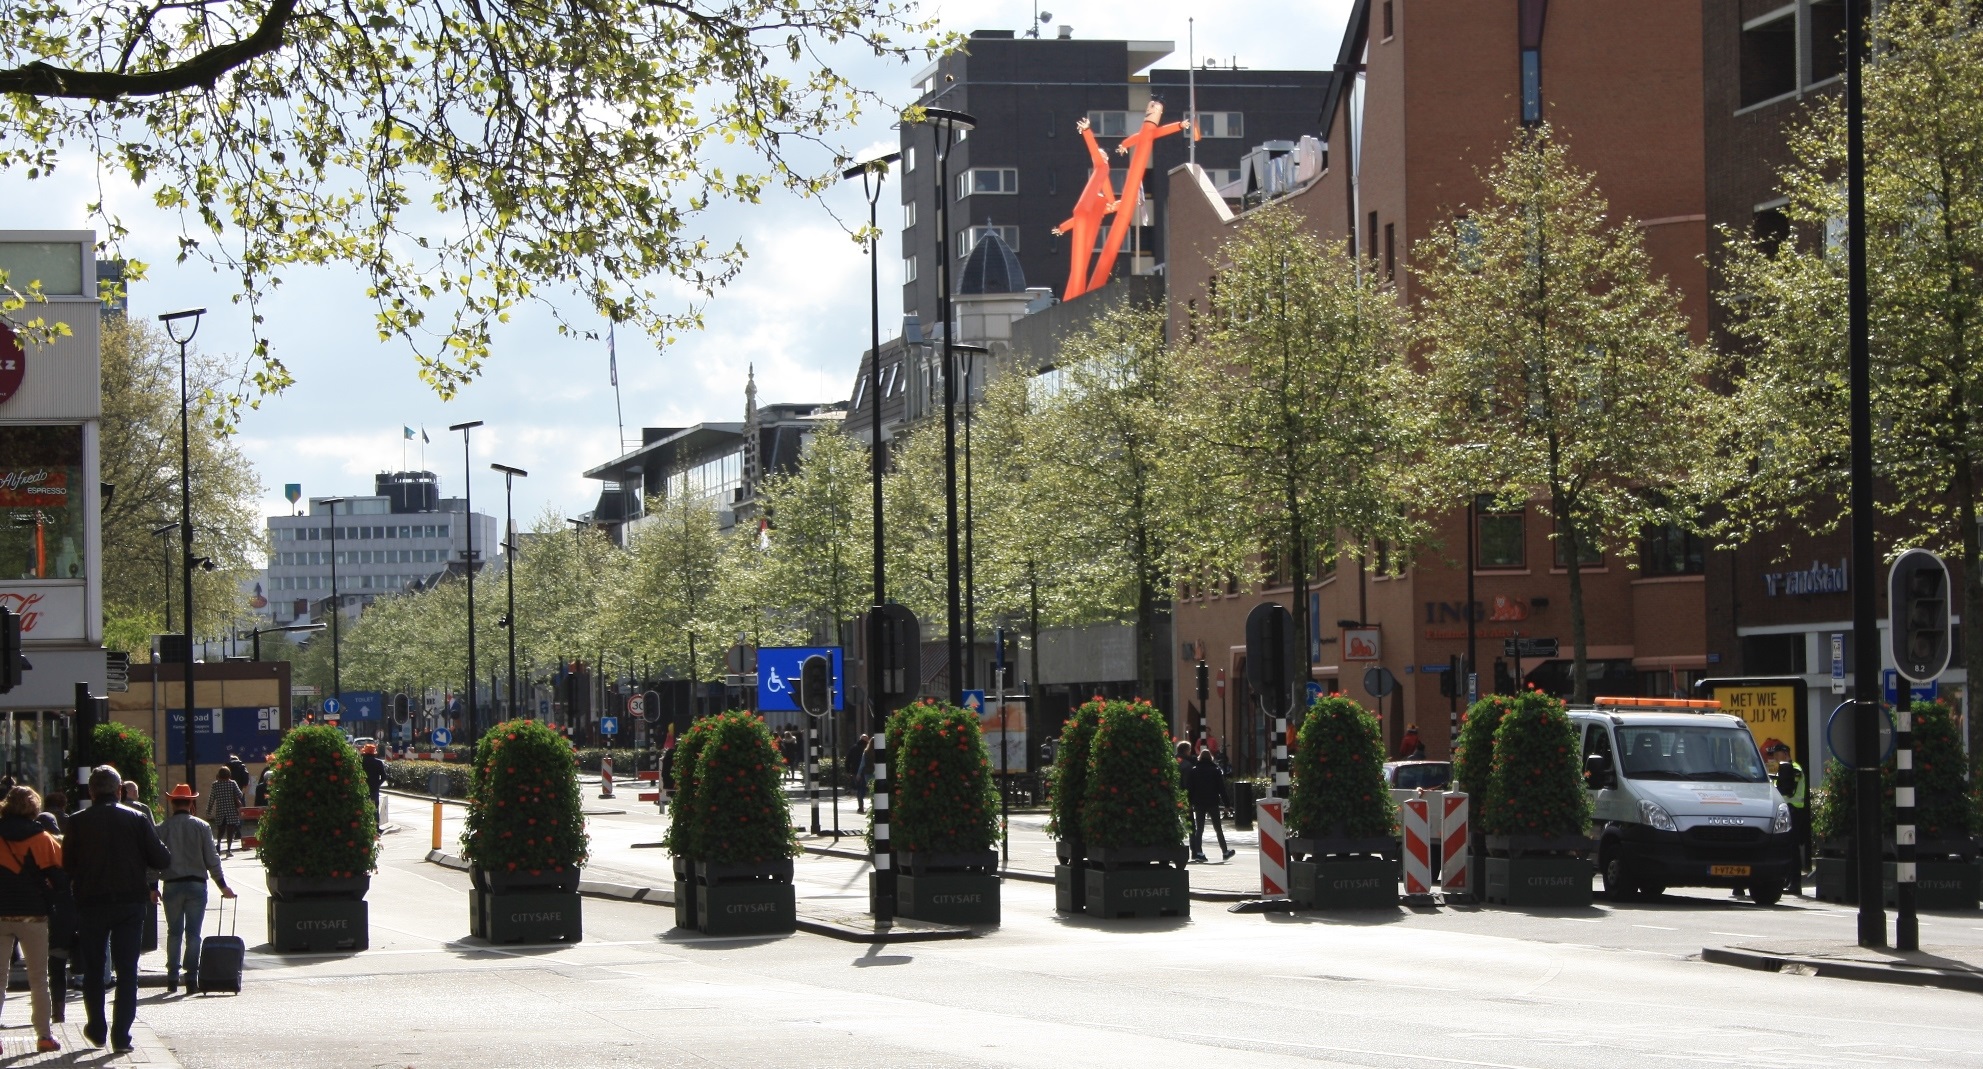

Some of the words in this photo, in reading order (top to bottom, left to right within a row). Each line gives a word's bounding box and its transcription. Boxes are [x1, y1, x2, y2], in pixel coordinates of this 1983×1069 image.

[0, 469, 48, 490] Alfredo
[27, 486, 67, 495] ESPRESSO
[1425, 601, 1486, 624] ING
[1914, 665, 1926, 673] 8.2
[1730, 693, 1753, 707] MET
[1757, 692, 1778, 707] WIE
[1750, 709, 1766, 722] JIJ
[1708, 817, 1744, 825] IVECO
[1333, 878, 1380, 889] CITYSAFE
[1528, 876, 1575, 886] CITYSAFE
[1917, 880, 1963, 889] CITYSAFE
[1122, 887, 1171, 898] CITYSAFE
[932, 894, 982, 904] CITYSAFE
[726, 902, 776, 914] CITYSAFE
[511, 912, 562, 923] CITYSAFE
[296, 919, 348, 930] CITYSAFE
